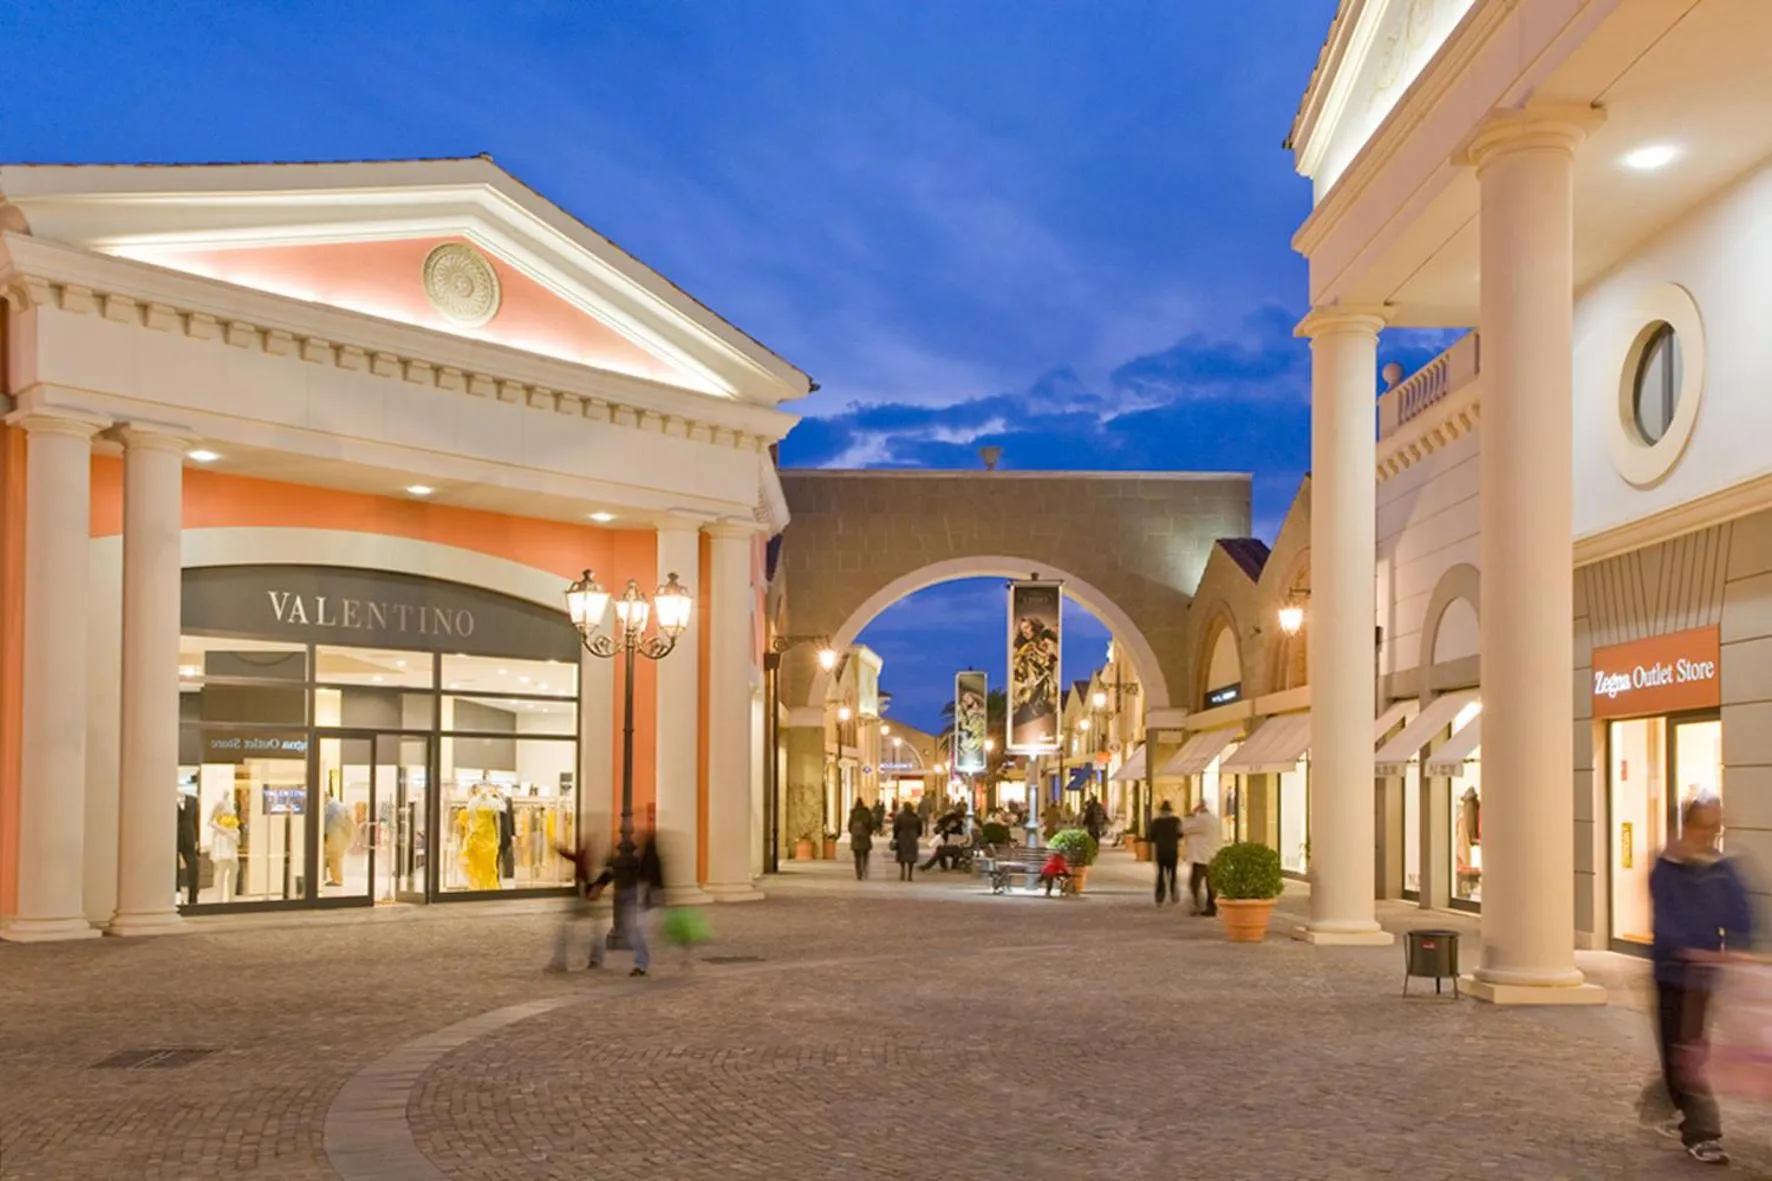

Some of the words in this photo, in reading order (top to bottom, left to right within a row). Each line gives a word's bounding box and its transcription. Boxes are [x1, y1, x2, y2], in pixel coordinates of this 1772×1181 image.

[267, 590, 475, 637] VALENTINO
[1593, 670, 1632, 698] Zegna
[1633, 662, 1673, 689] Outlet
[1676, 658, 1715, 683] Store
